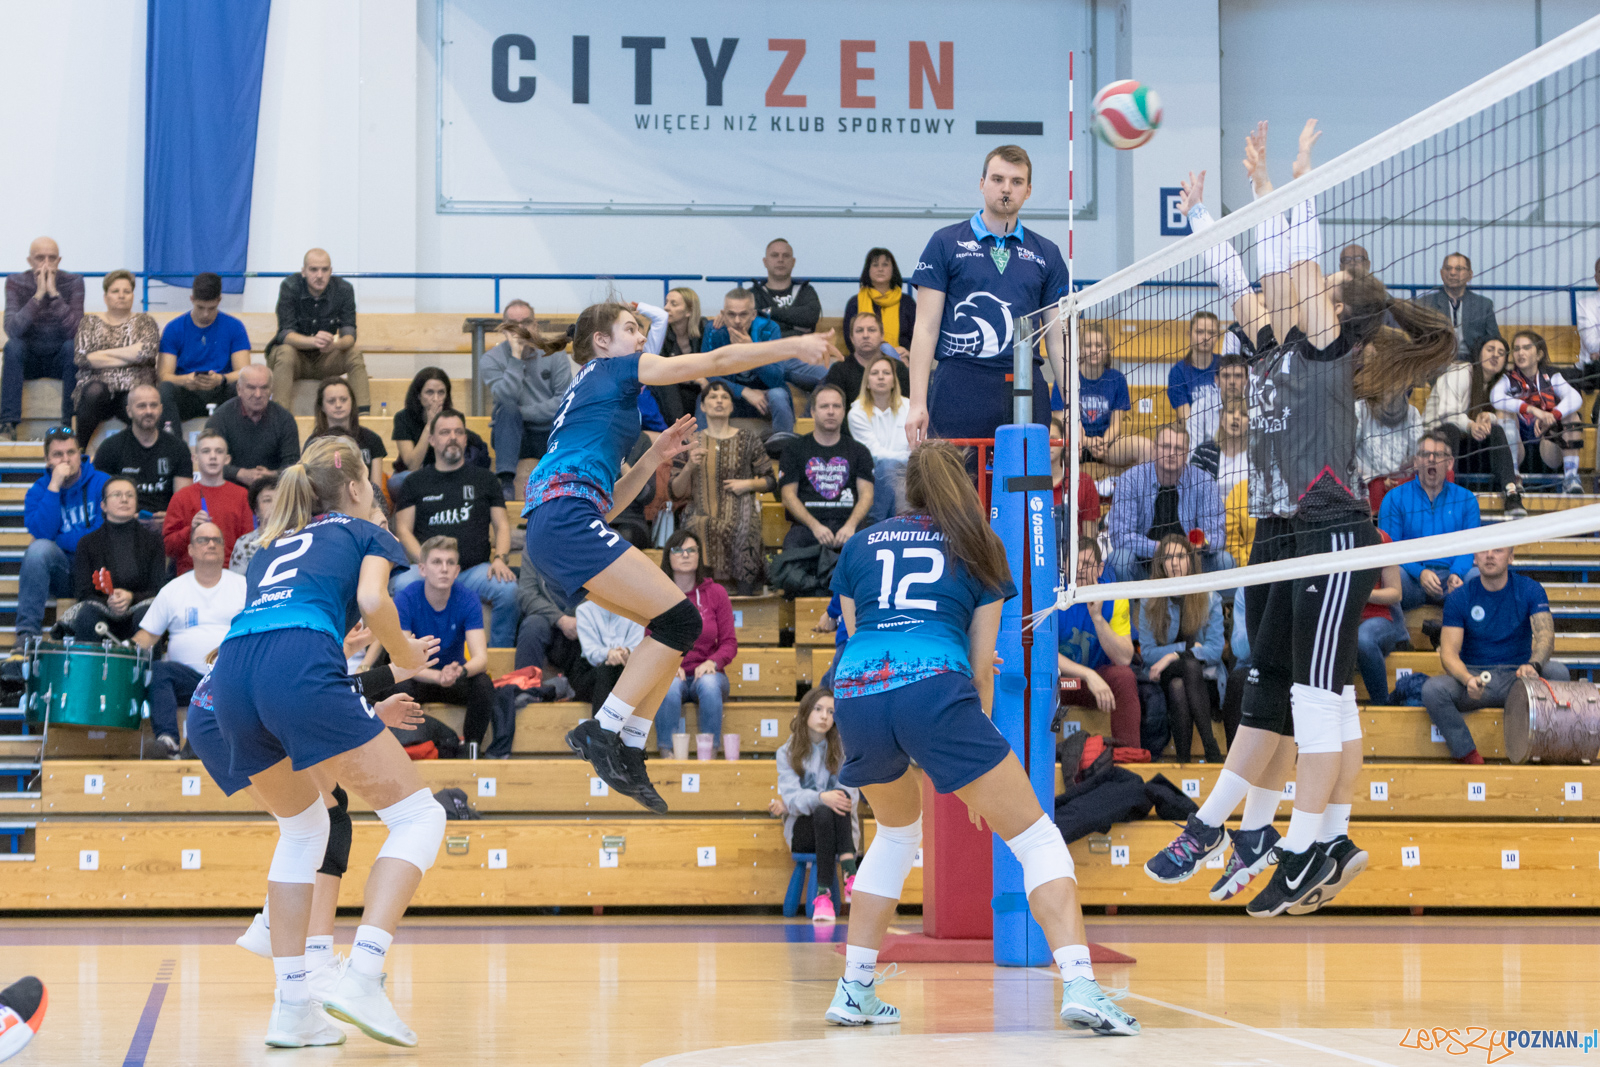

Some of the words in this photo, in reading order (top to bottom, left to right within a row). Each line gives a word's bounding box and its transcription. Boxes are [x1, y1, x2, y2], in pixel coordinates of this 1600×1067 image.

[491, 33, 955, 110] CITYZEN
[634, 113, 710, 134] WIĘCEJ
[724, 113, 758, 131] NIŻ
[770, 116, 825, 132] KLUB
[838, 117, 955, 134] SPORTOWY
[1167, 195, 1187, 229] B
[1032, 513, 1045, 567] Senoh
[258, 532, 314, 588] 2
[876, 547, 945, 612] 12
[189, 779, 194, 789] 7
[484, 781, 490, 790] 4
[597, 780, 602, 790] 3
[688, 777, 694, 786] 2
[1186, 782, 1196, 792] 13
[1375, 785, 1384, 795] 11
[1472, 785, 1482, 795] 10
[1571, 785, 1577, 795] 9
[189, 853, 194, 862] 7
[495, 852, 500, 862] 4
[704, 850, 710, 860] 2
[1115, 849, 1126, 858] 14
[1406, 850, 1416, 860] 11
[1506, 853, 1516, 862] 10
